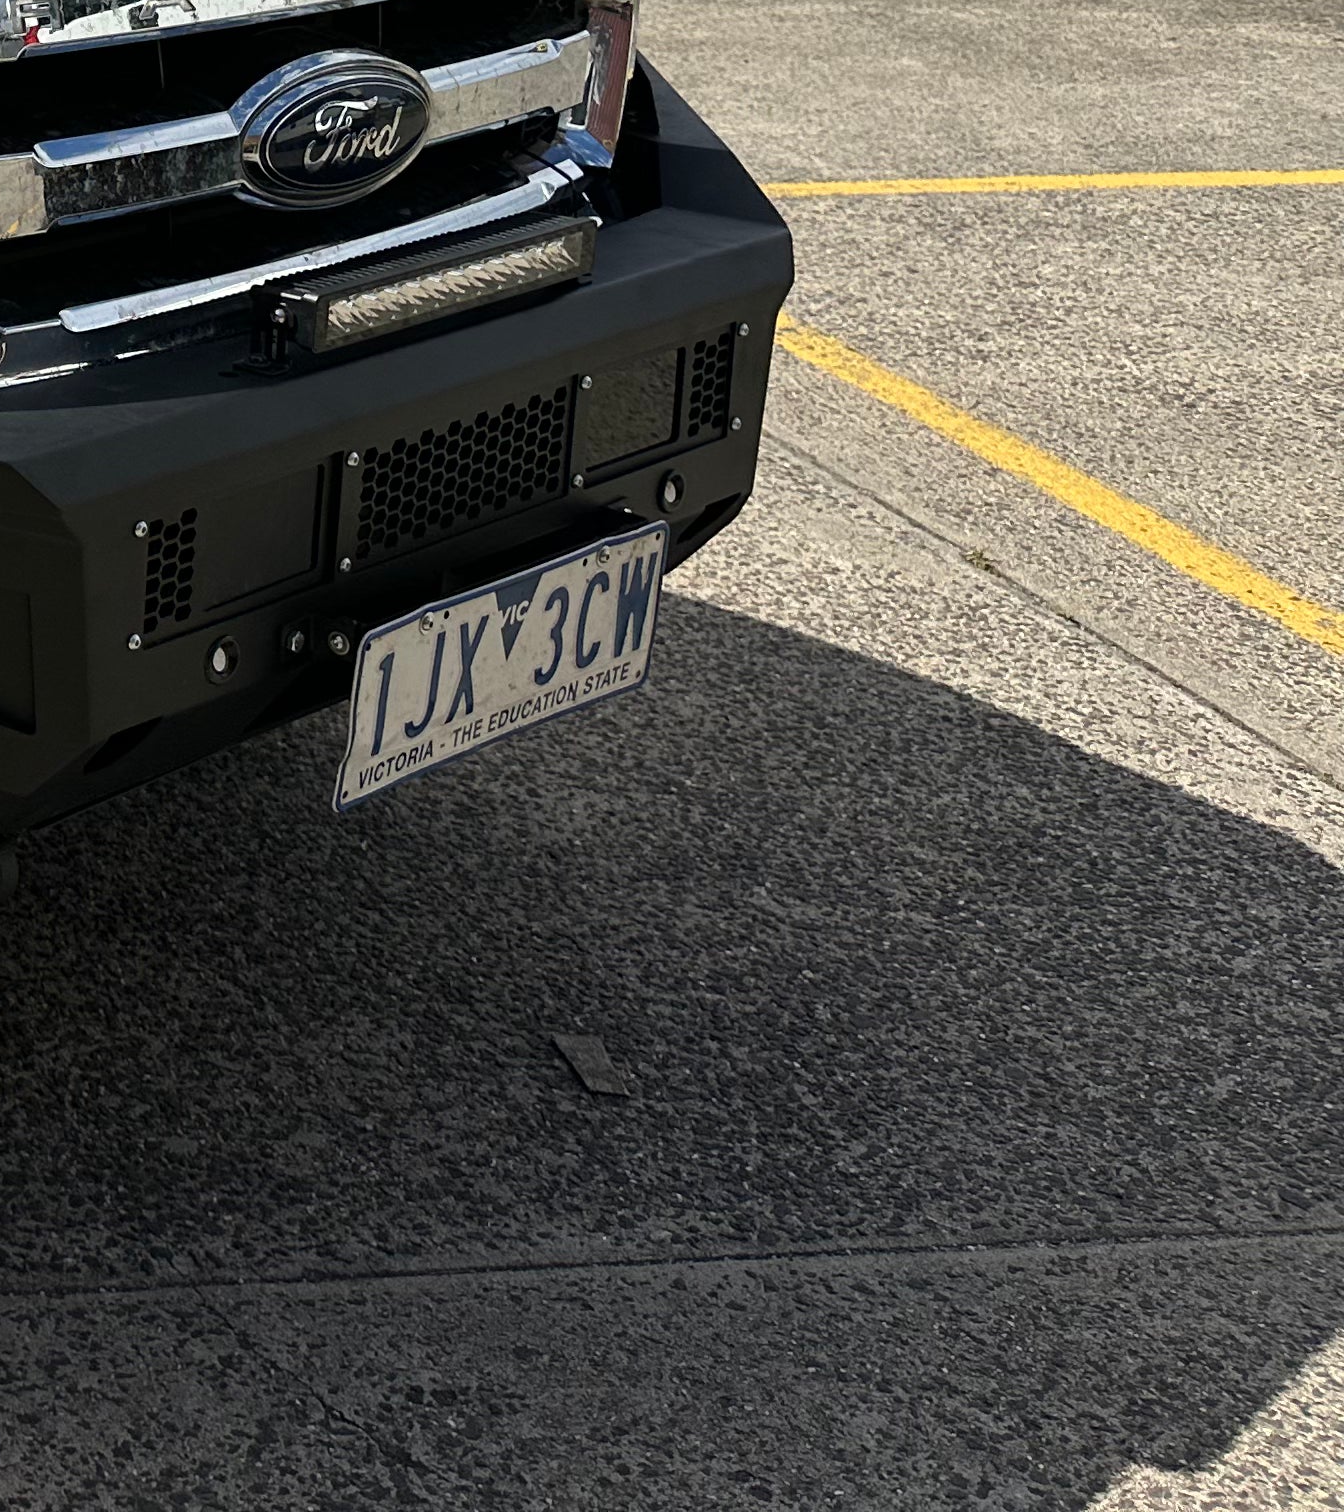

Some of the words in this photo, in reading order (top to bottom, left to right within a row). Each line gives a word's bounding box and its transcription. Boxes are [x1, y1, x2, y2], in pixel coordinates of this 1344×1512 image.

[303, 95, 403, 172] Ford
[497, 599, 531, 629] VIC
[358, 740, 434, 789] VICTORIA
[452, 717, 483, 748] THE
[487, 680, 579, 732] EDUCATION
[583, 661, 632, 695] STATE
